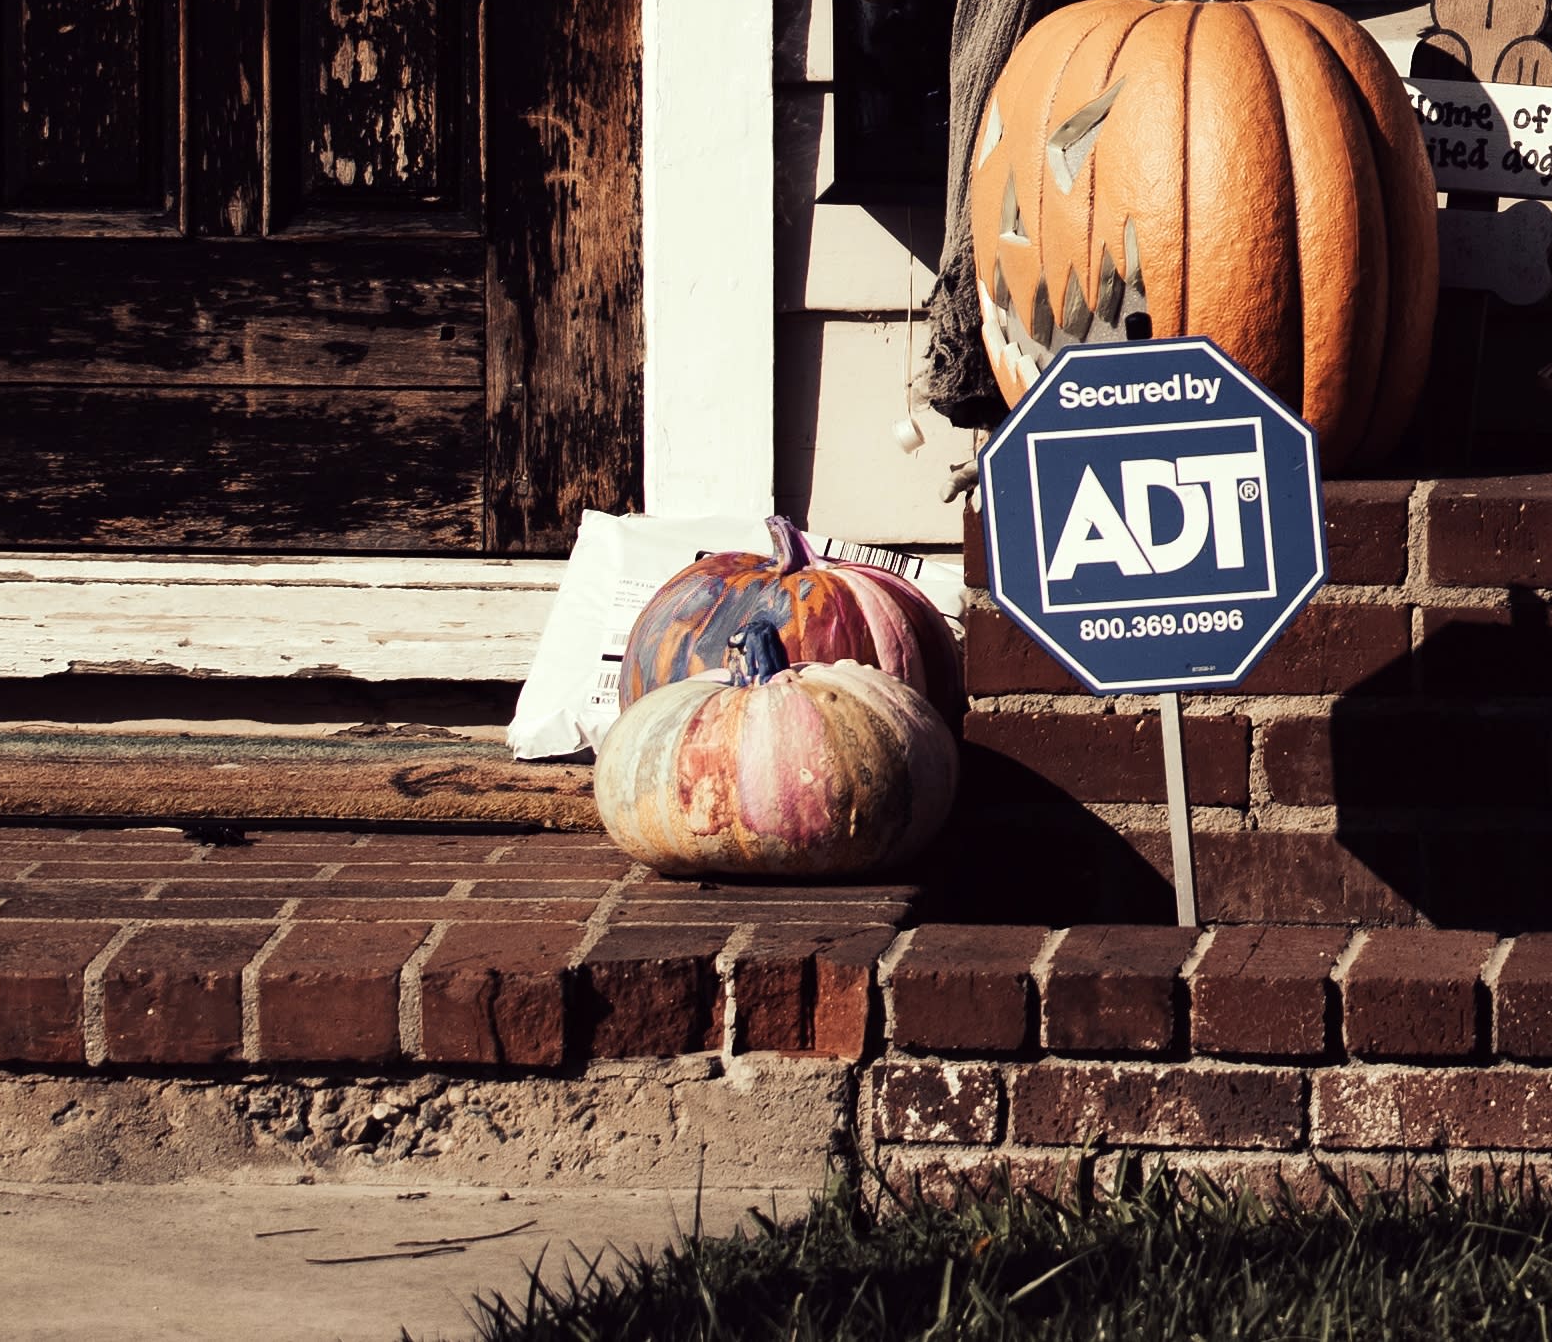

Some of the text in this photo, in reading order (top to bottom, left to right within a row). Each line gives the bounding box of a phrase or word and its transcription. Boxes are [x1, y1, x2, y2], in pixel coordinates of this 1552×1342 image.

[1513, 104, 1552, 134] of
[1059, 373, 1221, 409] Secured by
[1047, 452, 1260, 581] ADT
[1079, 609, 1244, 641] 800.369.0996
